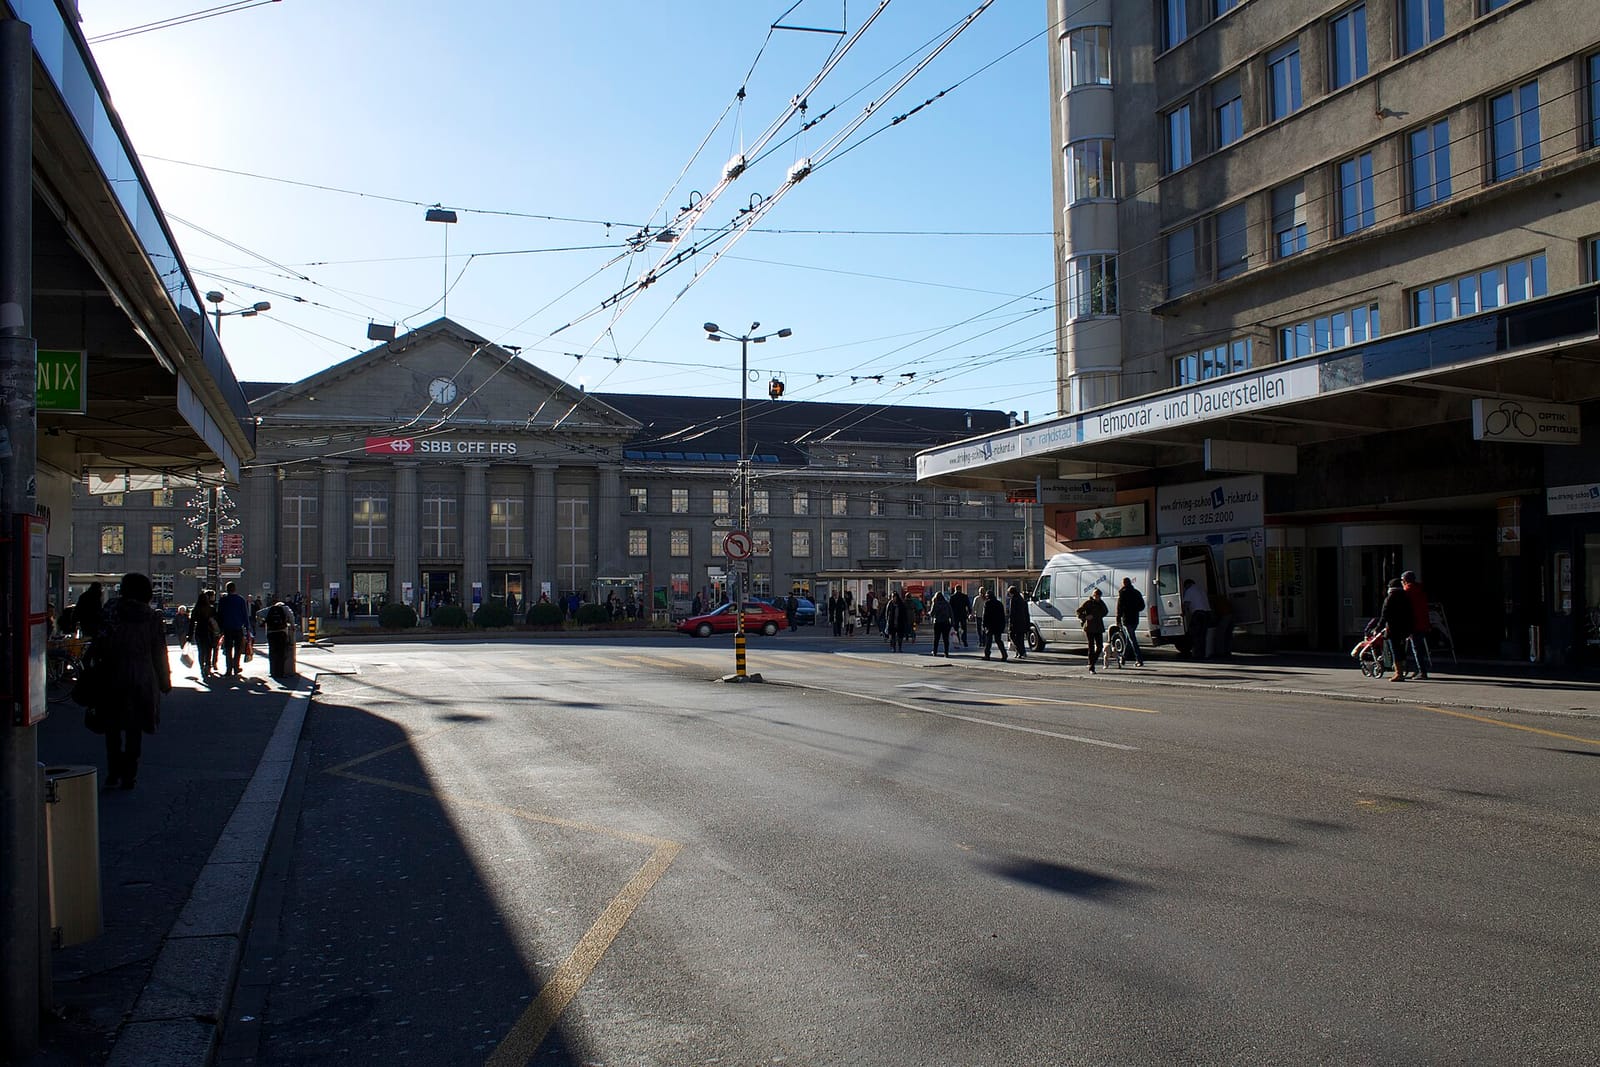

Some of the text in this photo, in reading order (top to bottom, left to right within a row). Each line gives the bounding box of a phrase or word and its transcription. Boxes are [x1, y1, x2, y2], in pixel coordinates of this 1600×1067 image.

[1097, 403, 1153, 434] Temporär
[1164, 393, 1189, 420] und
[1193, 376, 1285, 414] Dauerstellen
[1538, 412, 1567, 421] OPTIK
[1038, 427, 1072, 445] randstad
[1538, 425, 1579, 434] OPTIQUE
[420, 440, 517, 455] SBB CFF FFS
